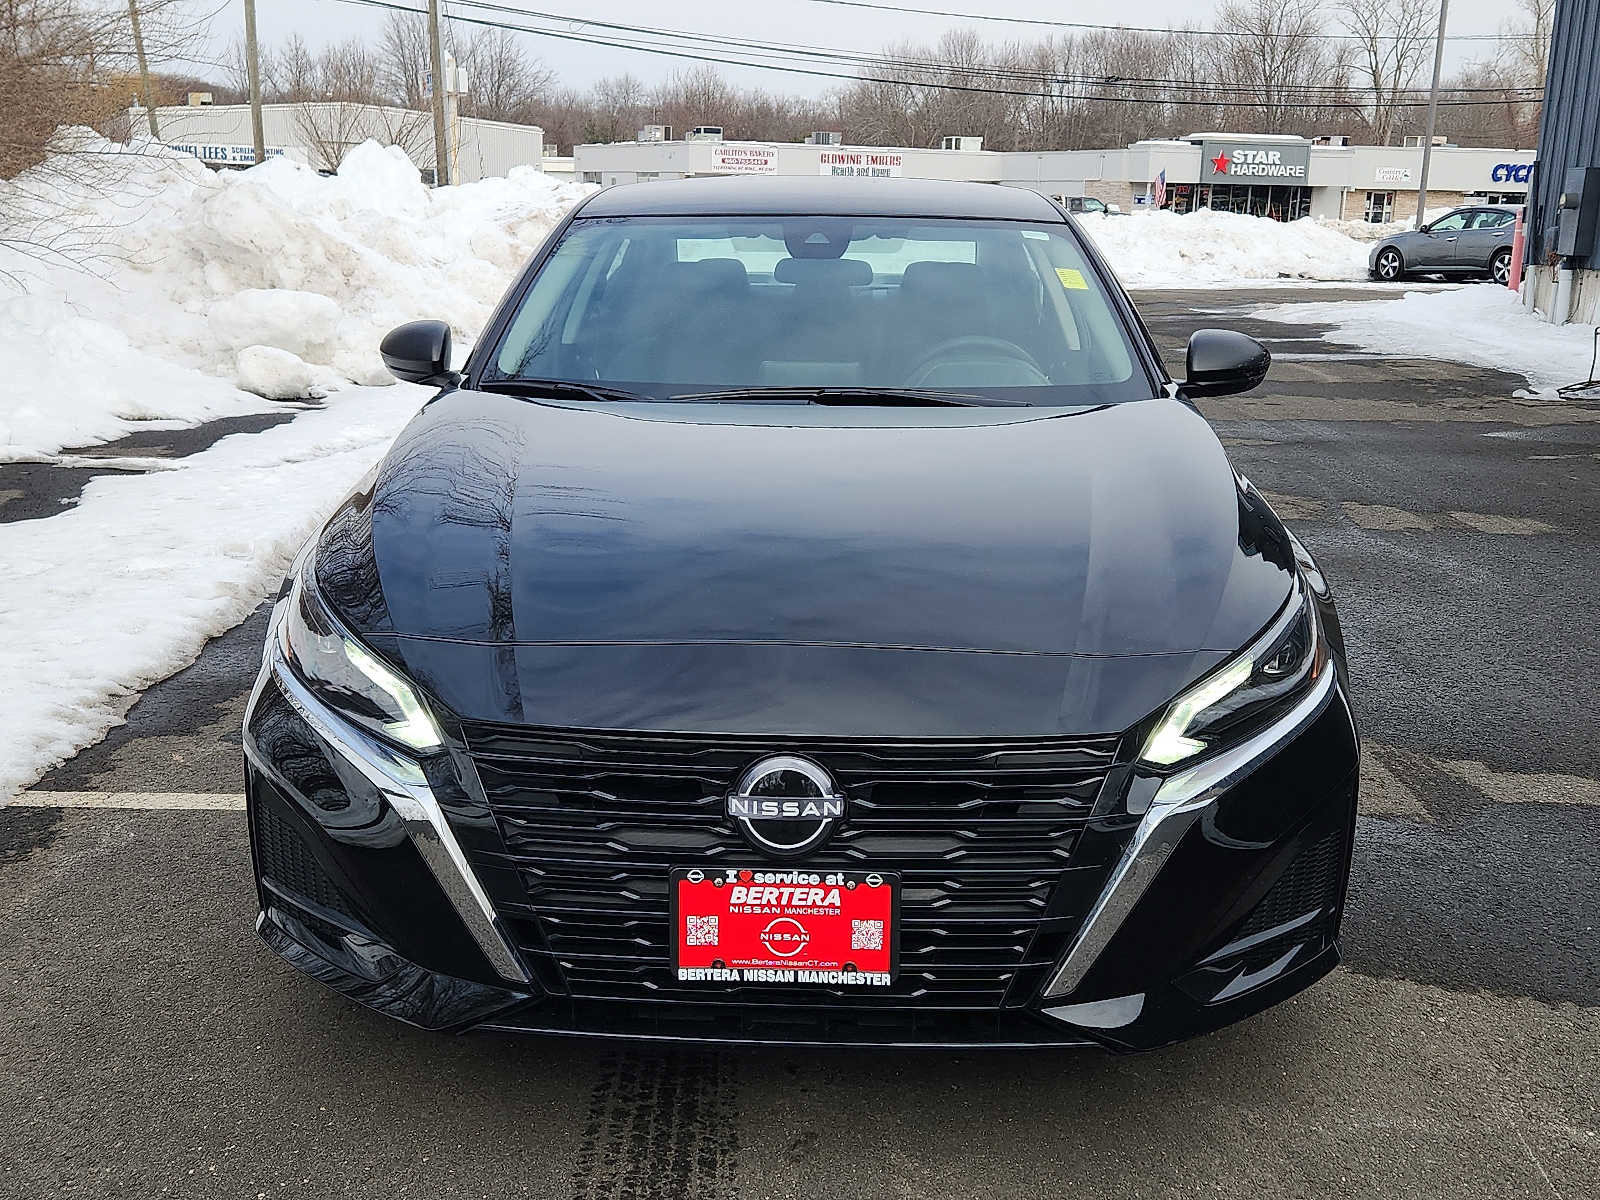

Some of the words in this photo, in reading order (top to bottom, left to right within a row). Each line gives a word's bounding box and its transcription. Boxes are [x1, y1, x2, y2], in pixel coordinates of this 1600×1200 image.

[202, 146, 227, 160] TEES
[749, 150, 776, 158] BAKERY
[820, 153, 862, 165] GLOWING
[866, 154, 902, 167] EMBERS
[1231, 149, 1281, 165] STAR
[856, 166, 870, 177] and
[1230, 164, 1305, 177] HARDWARE
[731, 799, 841, 817] NISSAN
[725, 869, 737, 884] I
[753, 871, 821, 886] service
[825, 872, 845, 886] at
[730, 886, 841, 906] BERTERA
[729, 905, 780, 914] NISSAN
[784, 907, 841, 916] MANCHESTER
[759, 932, 810, 942] NISSAN
[731, 958, 838, 968] www.BerteraNissanCT.com
[678, 968, 741, 981] BERTERA
[743, 969, 795, 983] NISSAN
[797, 970, 891, 986] MANCHESTER
